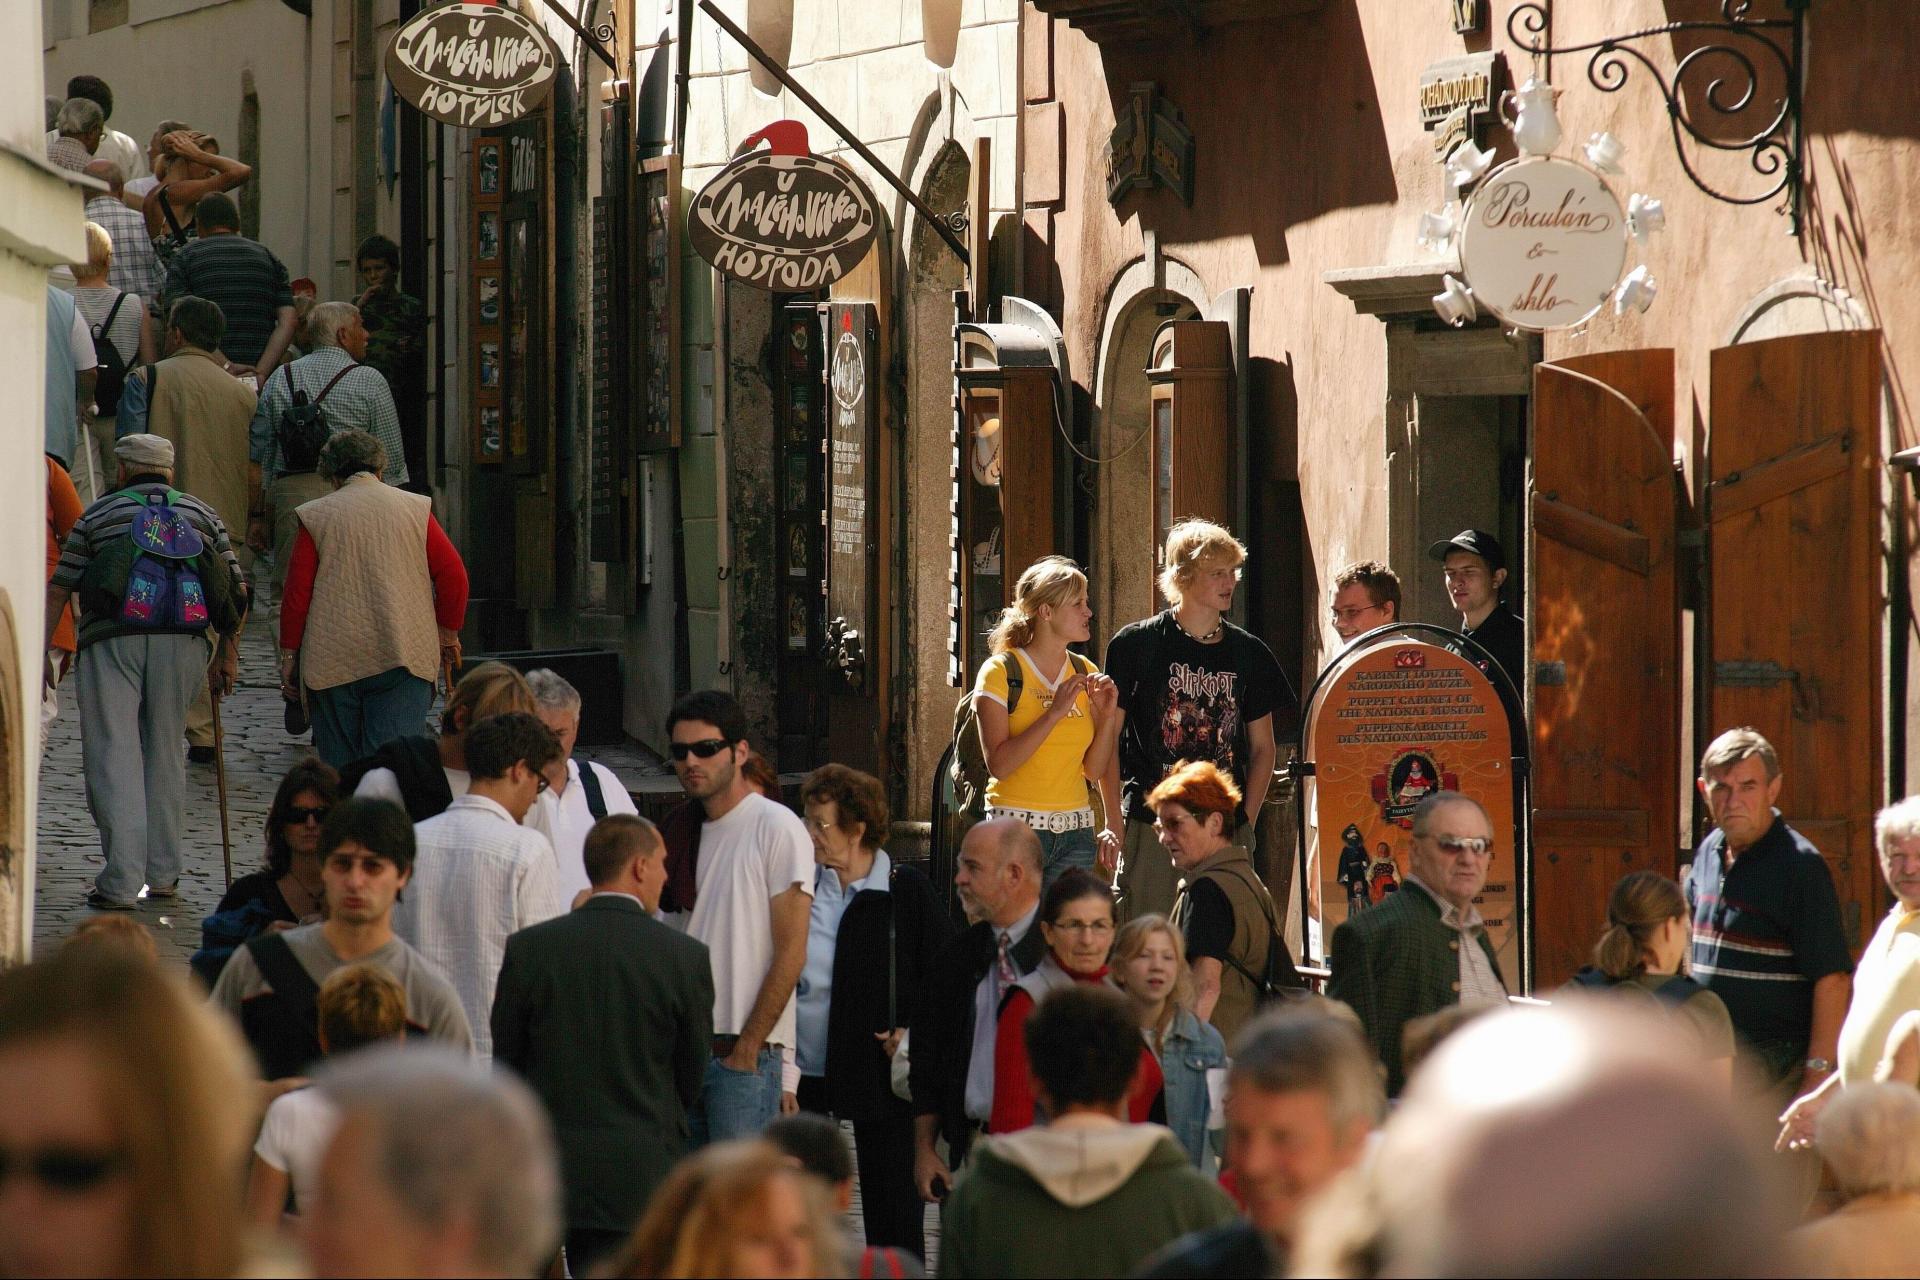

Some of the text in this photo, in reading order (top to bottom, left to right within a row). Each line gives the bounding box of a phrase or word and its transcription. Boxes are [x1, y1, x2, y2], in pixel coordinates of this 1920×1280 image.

[468, 18, 485, 37] U
[777, 171, 797, 192] U
[1526, 242, 1558, 260] &
[713, 241, 842, 288] HOSPODA
[1356, 669, 1464, 681] KABINET LOUTEK
[1427, 679, 1472, 689] MUZEA
[1350, 694, 1472, 706] PUPPET CABINET OF
[1338, 705, 1485, 718] THE NATIONAL MUSEUM
[1356, 721, 1468, 733] PUPPENKABINETT
[1337, 731, 1487, 744] DES NATIONALMUSEUMS
